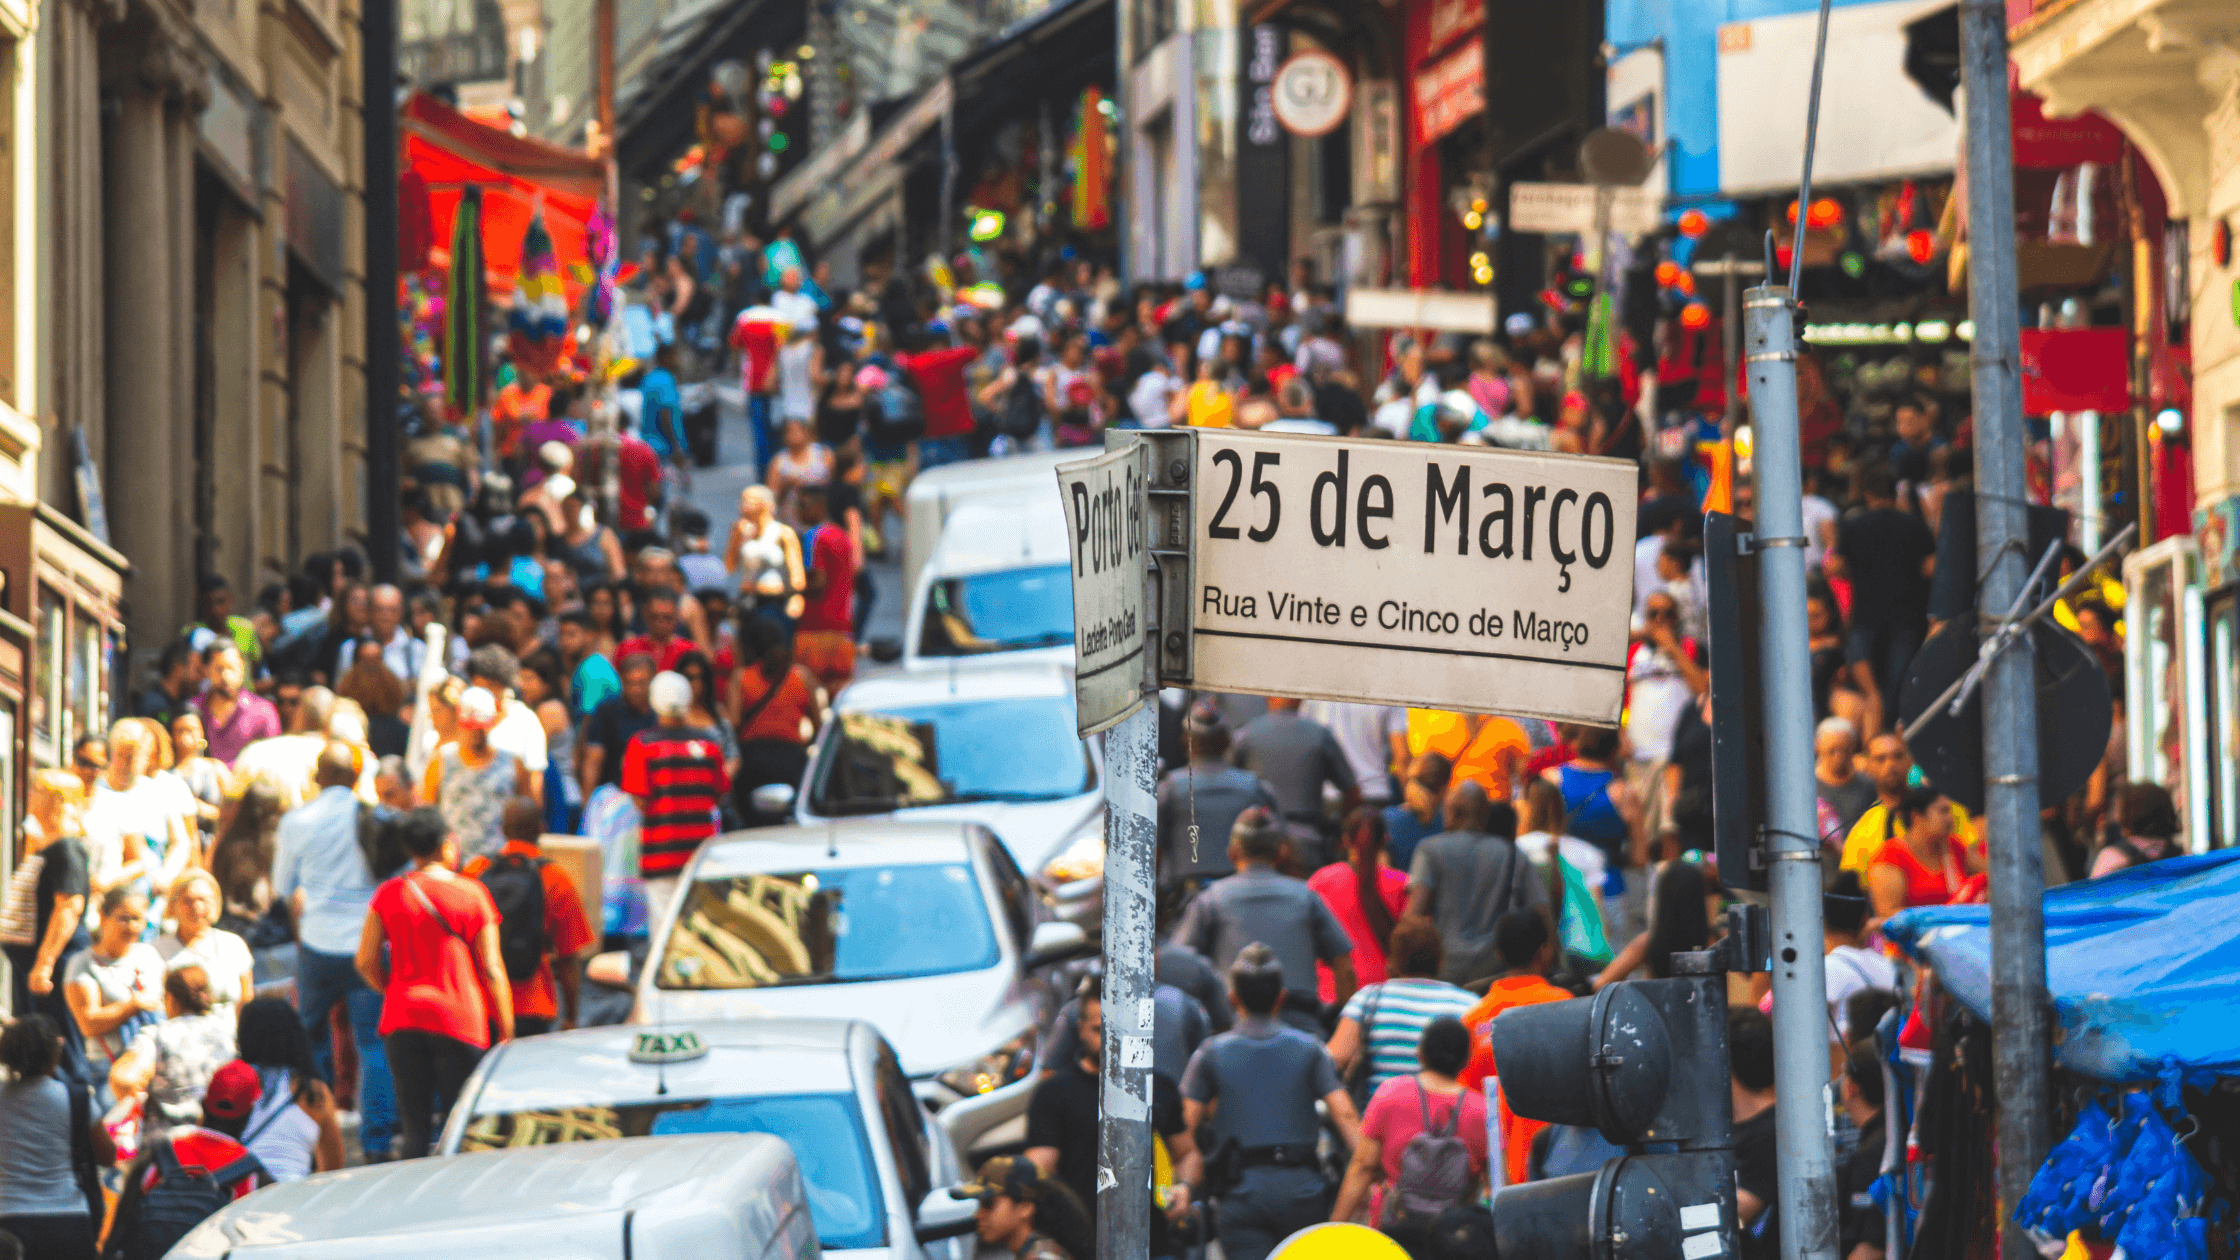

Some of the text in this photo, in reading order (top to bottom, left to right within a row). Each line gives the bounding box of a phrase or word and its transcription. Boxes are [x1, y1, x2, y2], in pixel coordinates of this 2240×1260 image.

[1071, 470, 1122, 578] Porto
[1126, 464, 1143, 560] Ger
[1208, 448, 1281, 543] 25
[1309, 449, 1394, 551] de
[1423, 462, 1614, 594] Março
[1081, 603, 1136, 658] Ladeira Porto Geral
[1202, 585, 1589, 651] Rua Vinte e Cinco de Março
[637, 1032, 699, 1053] TAXI
